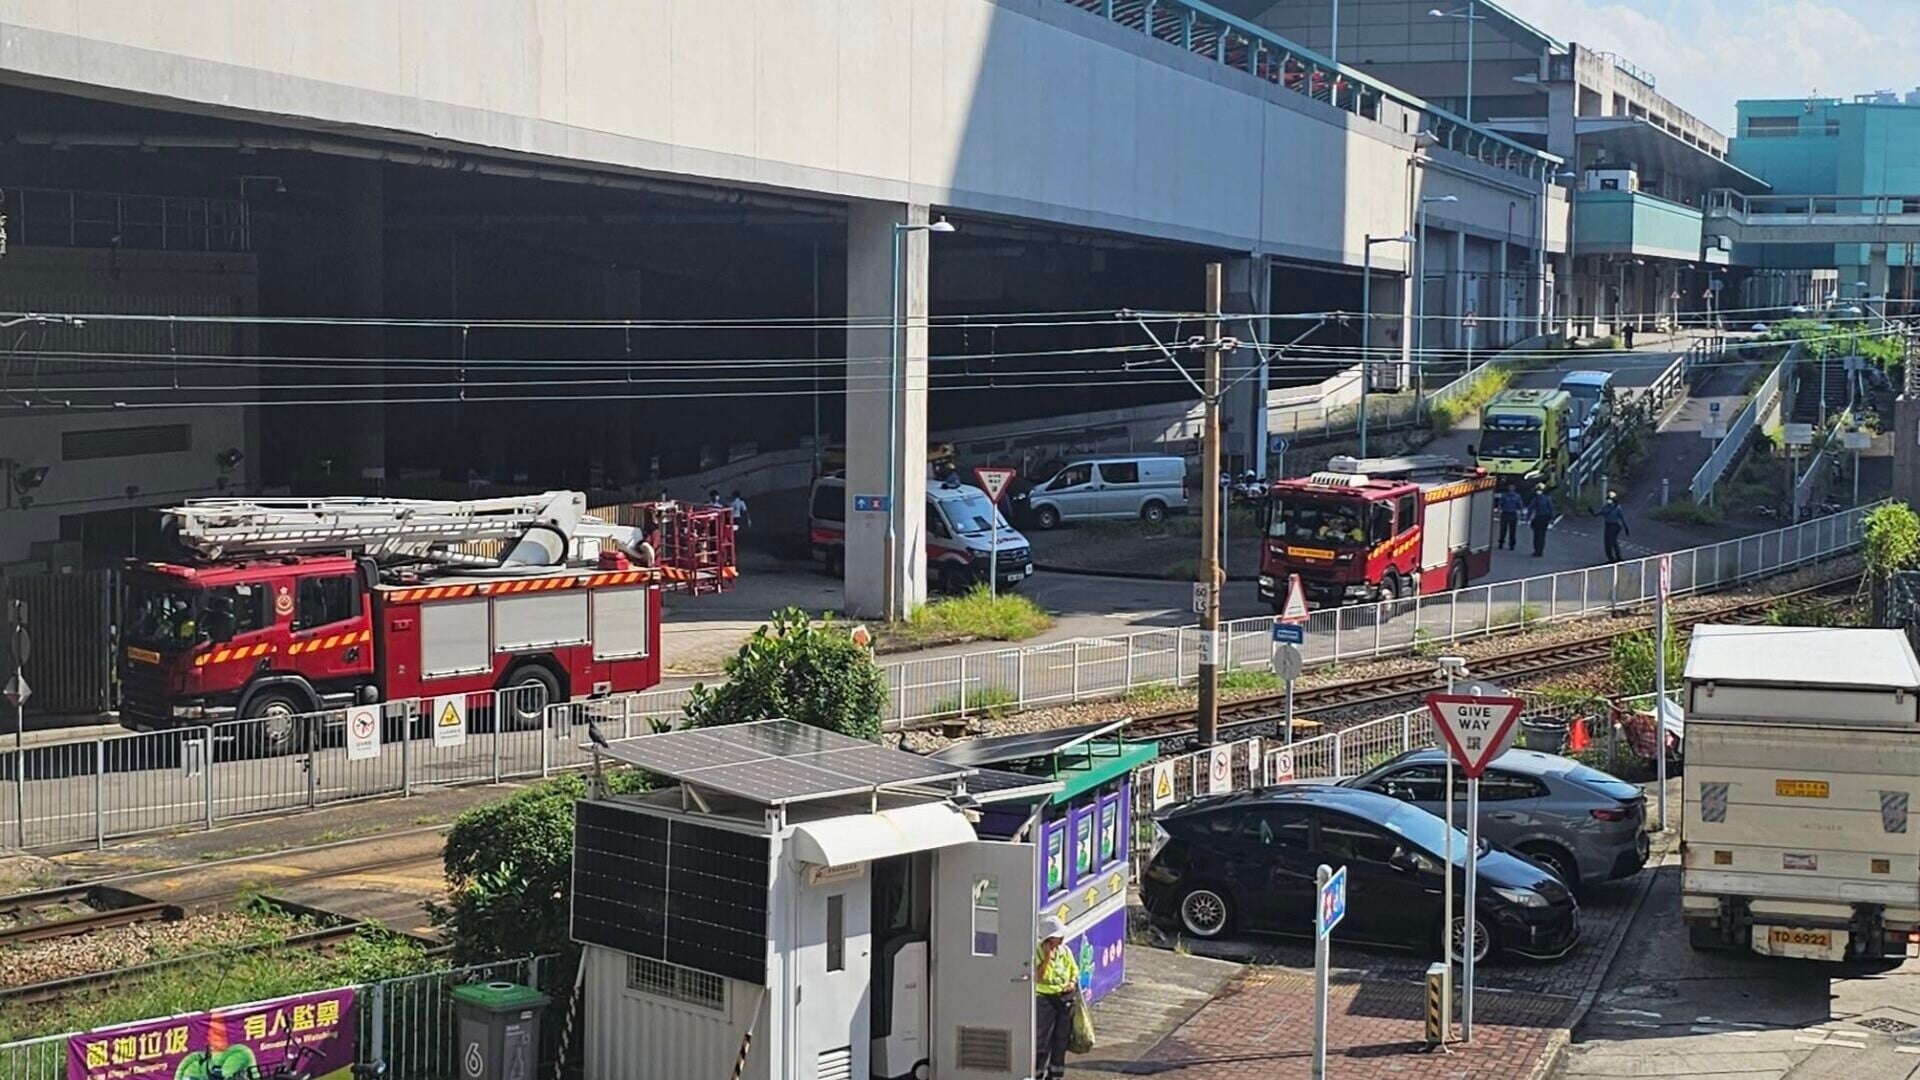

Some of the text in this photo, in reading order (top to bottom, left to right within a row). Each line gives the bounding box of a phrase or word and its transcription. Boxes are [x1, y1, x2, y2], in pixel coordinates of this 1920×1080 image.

[1195, 601, 1207, 612] LS
[1458, 705, 1491, 717] GIVE
[1458, 719, 1490, 730] WAY
[1774, 931, 1827, 946] TD 6922
[243, 999, 340, 1041] 有人監察
[465, 1042, 483, 1077] 6
